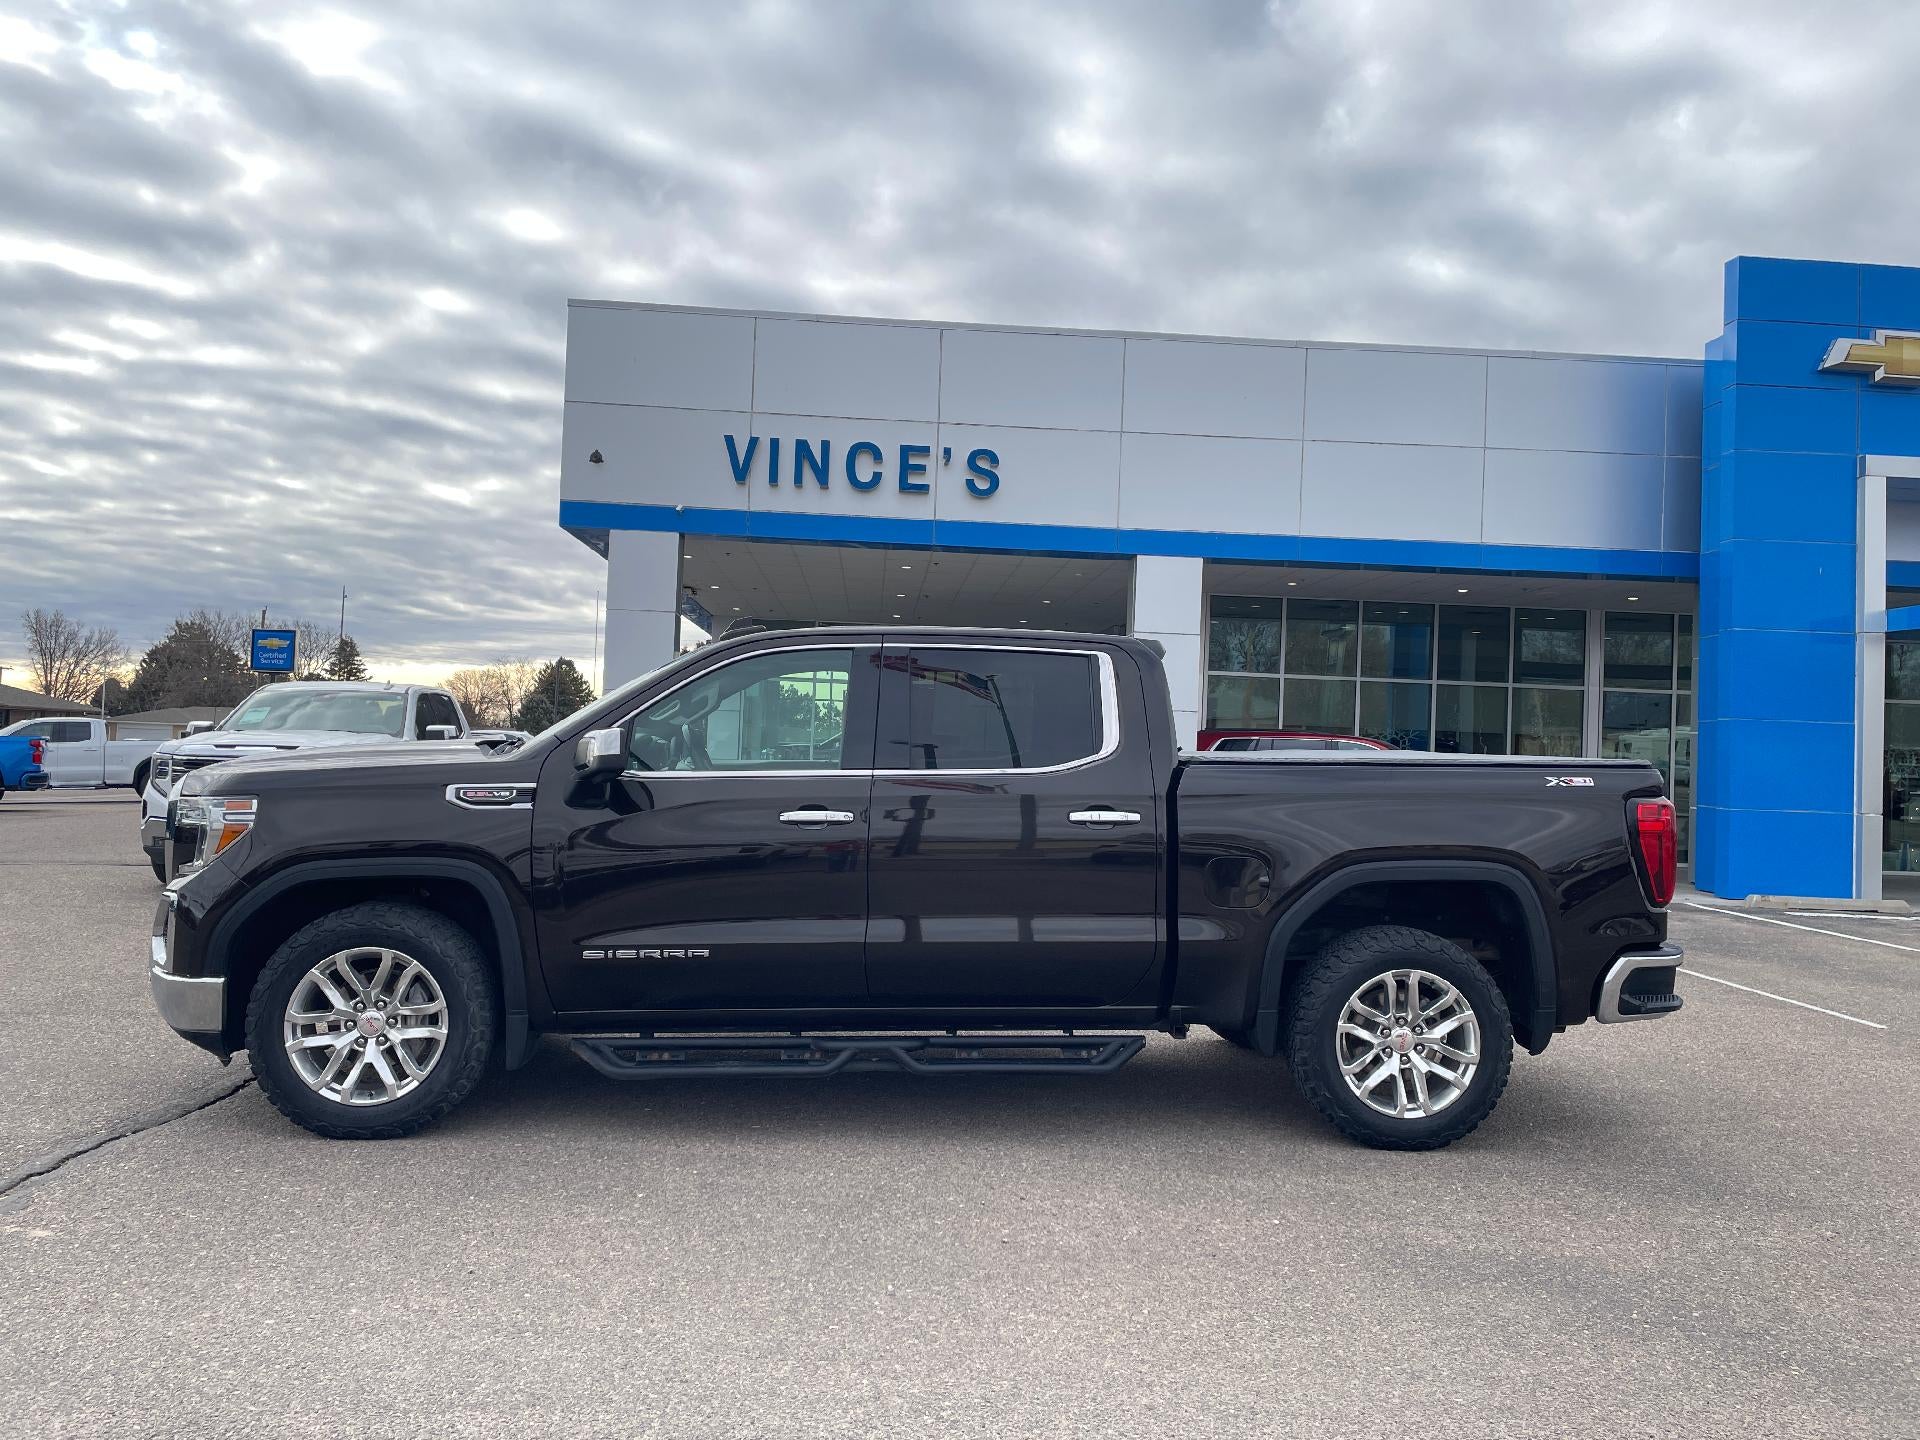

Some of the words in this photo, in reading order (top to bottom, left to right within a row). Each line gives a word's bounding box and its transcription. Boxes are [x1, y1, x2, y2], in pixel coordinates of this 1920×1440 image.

[723, 434, 1000, 498] VINCE'S
[258, 651, 287, 659] Certified
[582, 949, 710, 959] SIERRA
